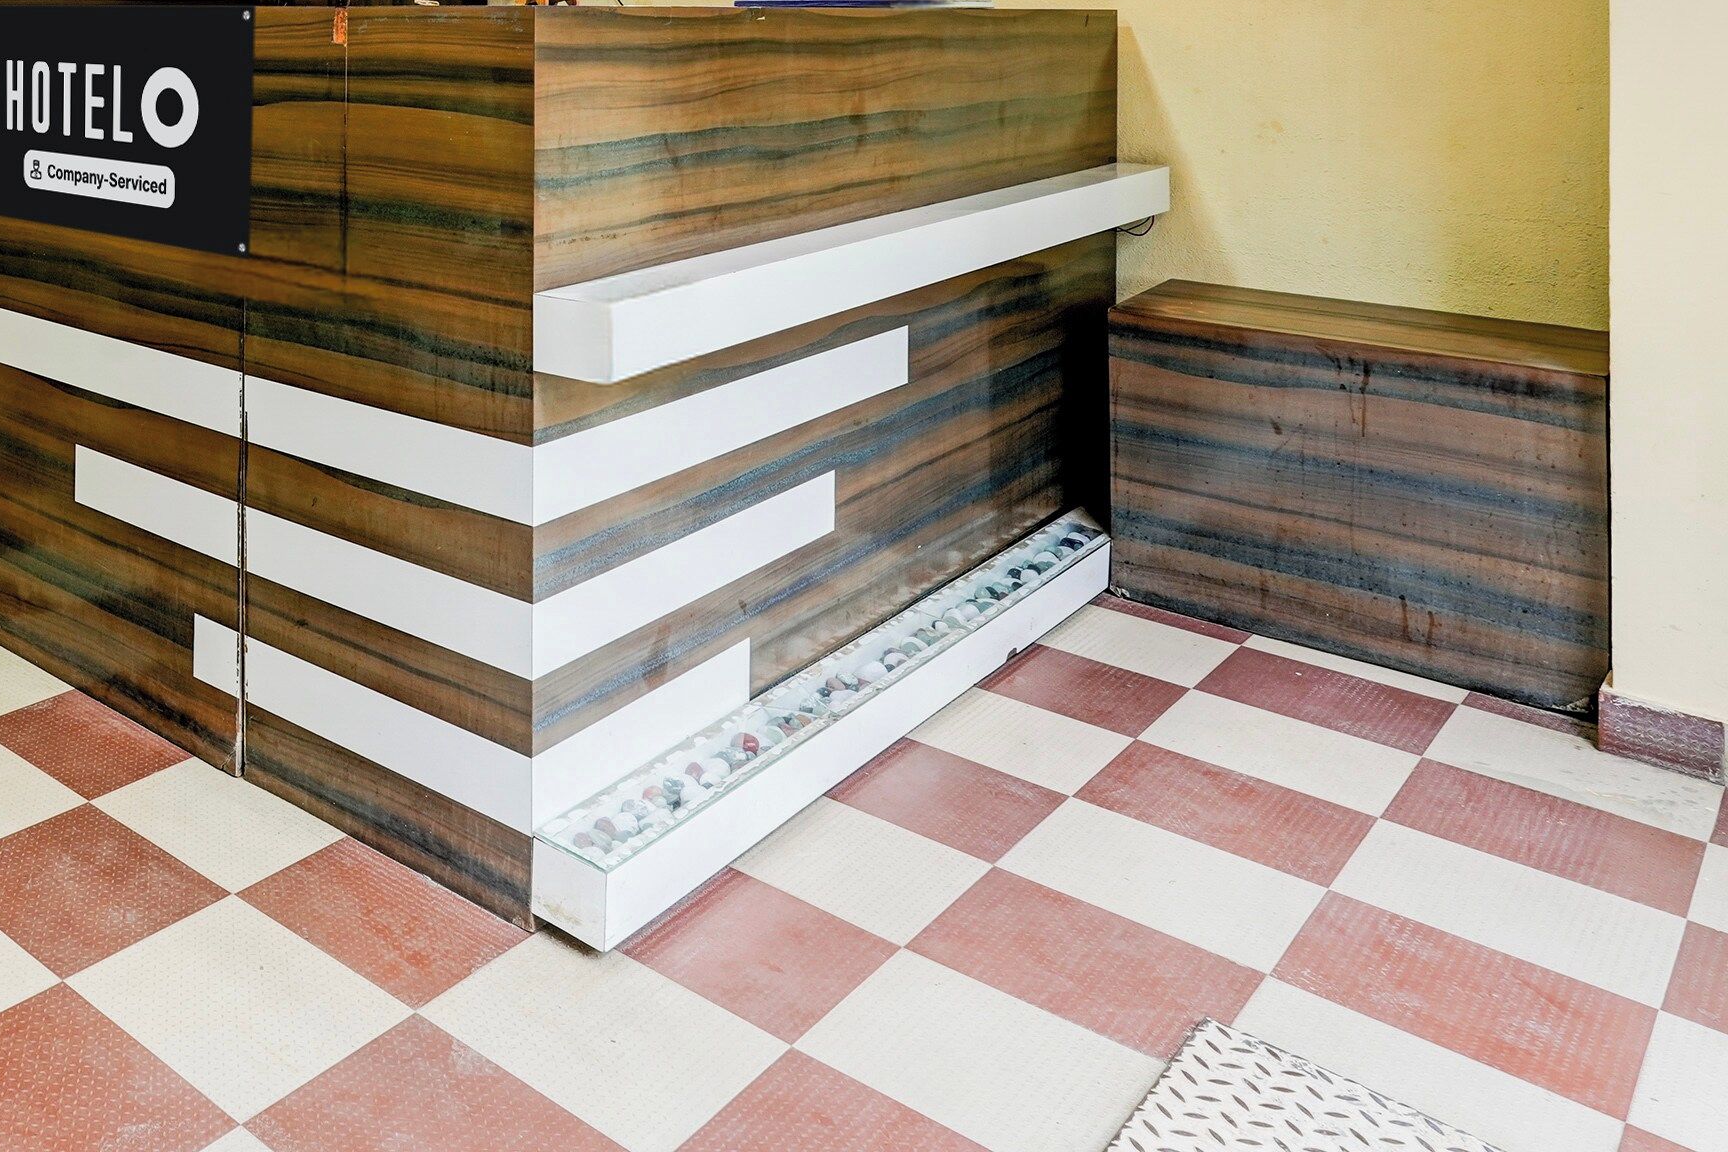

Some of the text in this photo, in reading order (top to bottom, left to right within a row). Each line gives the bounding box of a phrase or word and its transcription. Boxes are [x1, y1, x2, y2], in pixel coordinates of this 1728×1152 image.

[6, 59, 200, 148] HOTEL O
[46, 164, 168, 195] Company-Serviced
